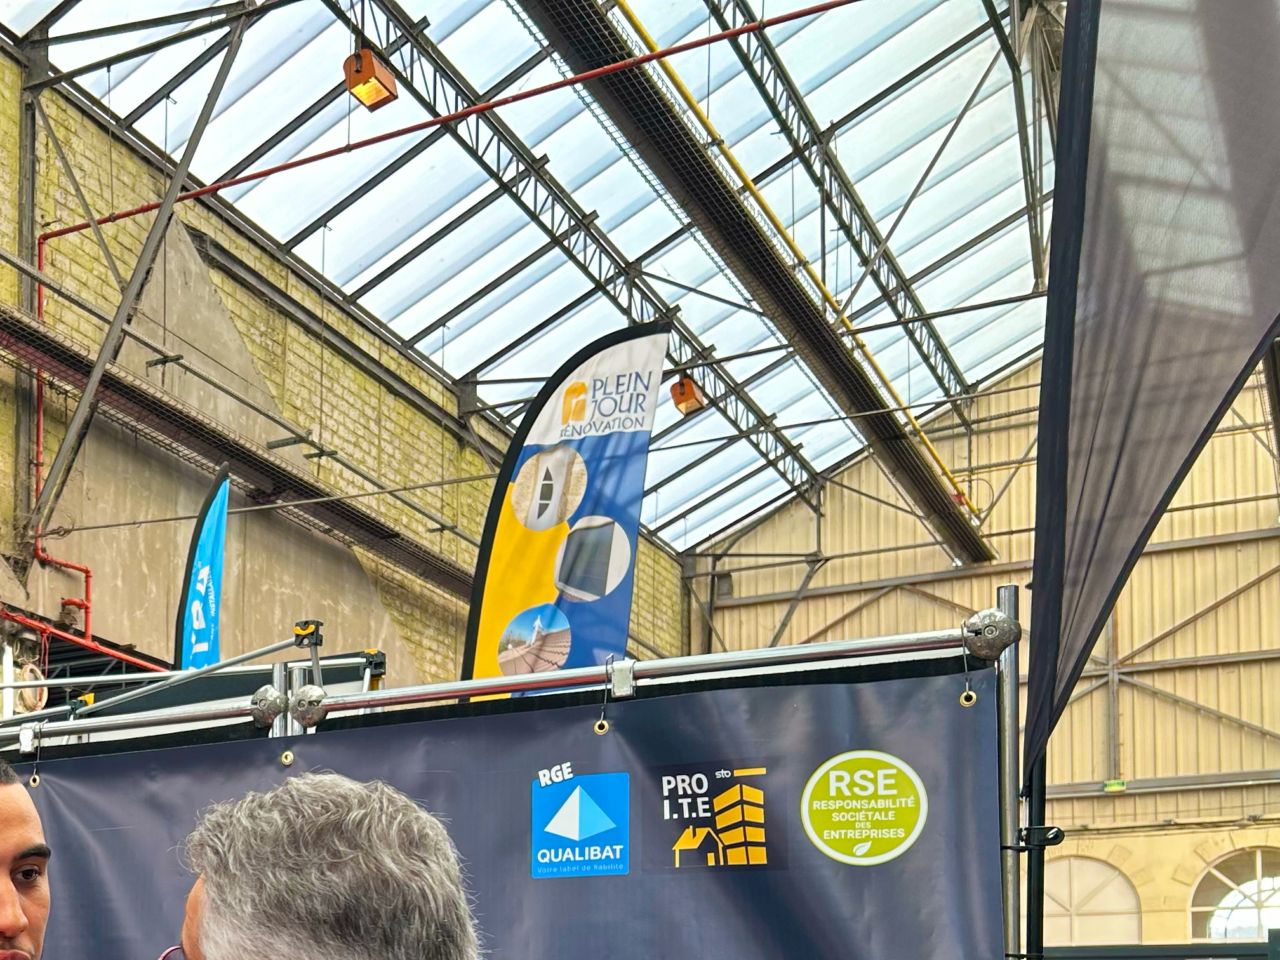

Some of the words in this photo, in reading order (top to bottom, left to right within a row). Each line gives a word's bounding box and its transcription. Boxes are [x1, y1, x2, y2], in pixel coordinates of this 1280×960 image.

[592, 371, 652, 399] PLEIN
[590, 393, 646, 421] JOUR
[538, 762, 574, 787] RGE
[662, 773, 709, 796] PRO
[714, 769, 732, 778] sto
[829, 768, 898, 796] RSE
[663, 797, 711, 820] I.T.E
[813, 795, 915, 810] RESPONSABILITÉ
[832, 810, 896, 822] SOCIÉTALE
[823, 828, 905, 839] ENTREPRISES
[537, 845, 624, 863] QUALIBAT
